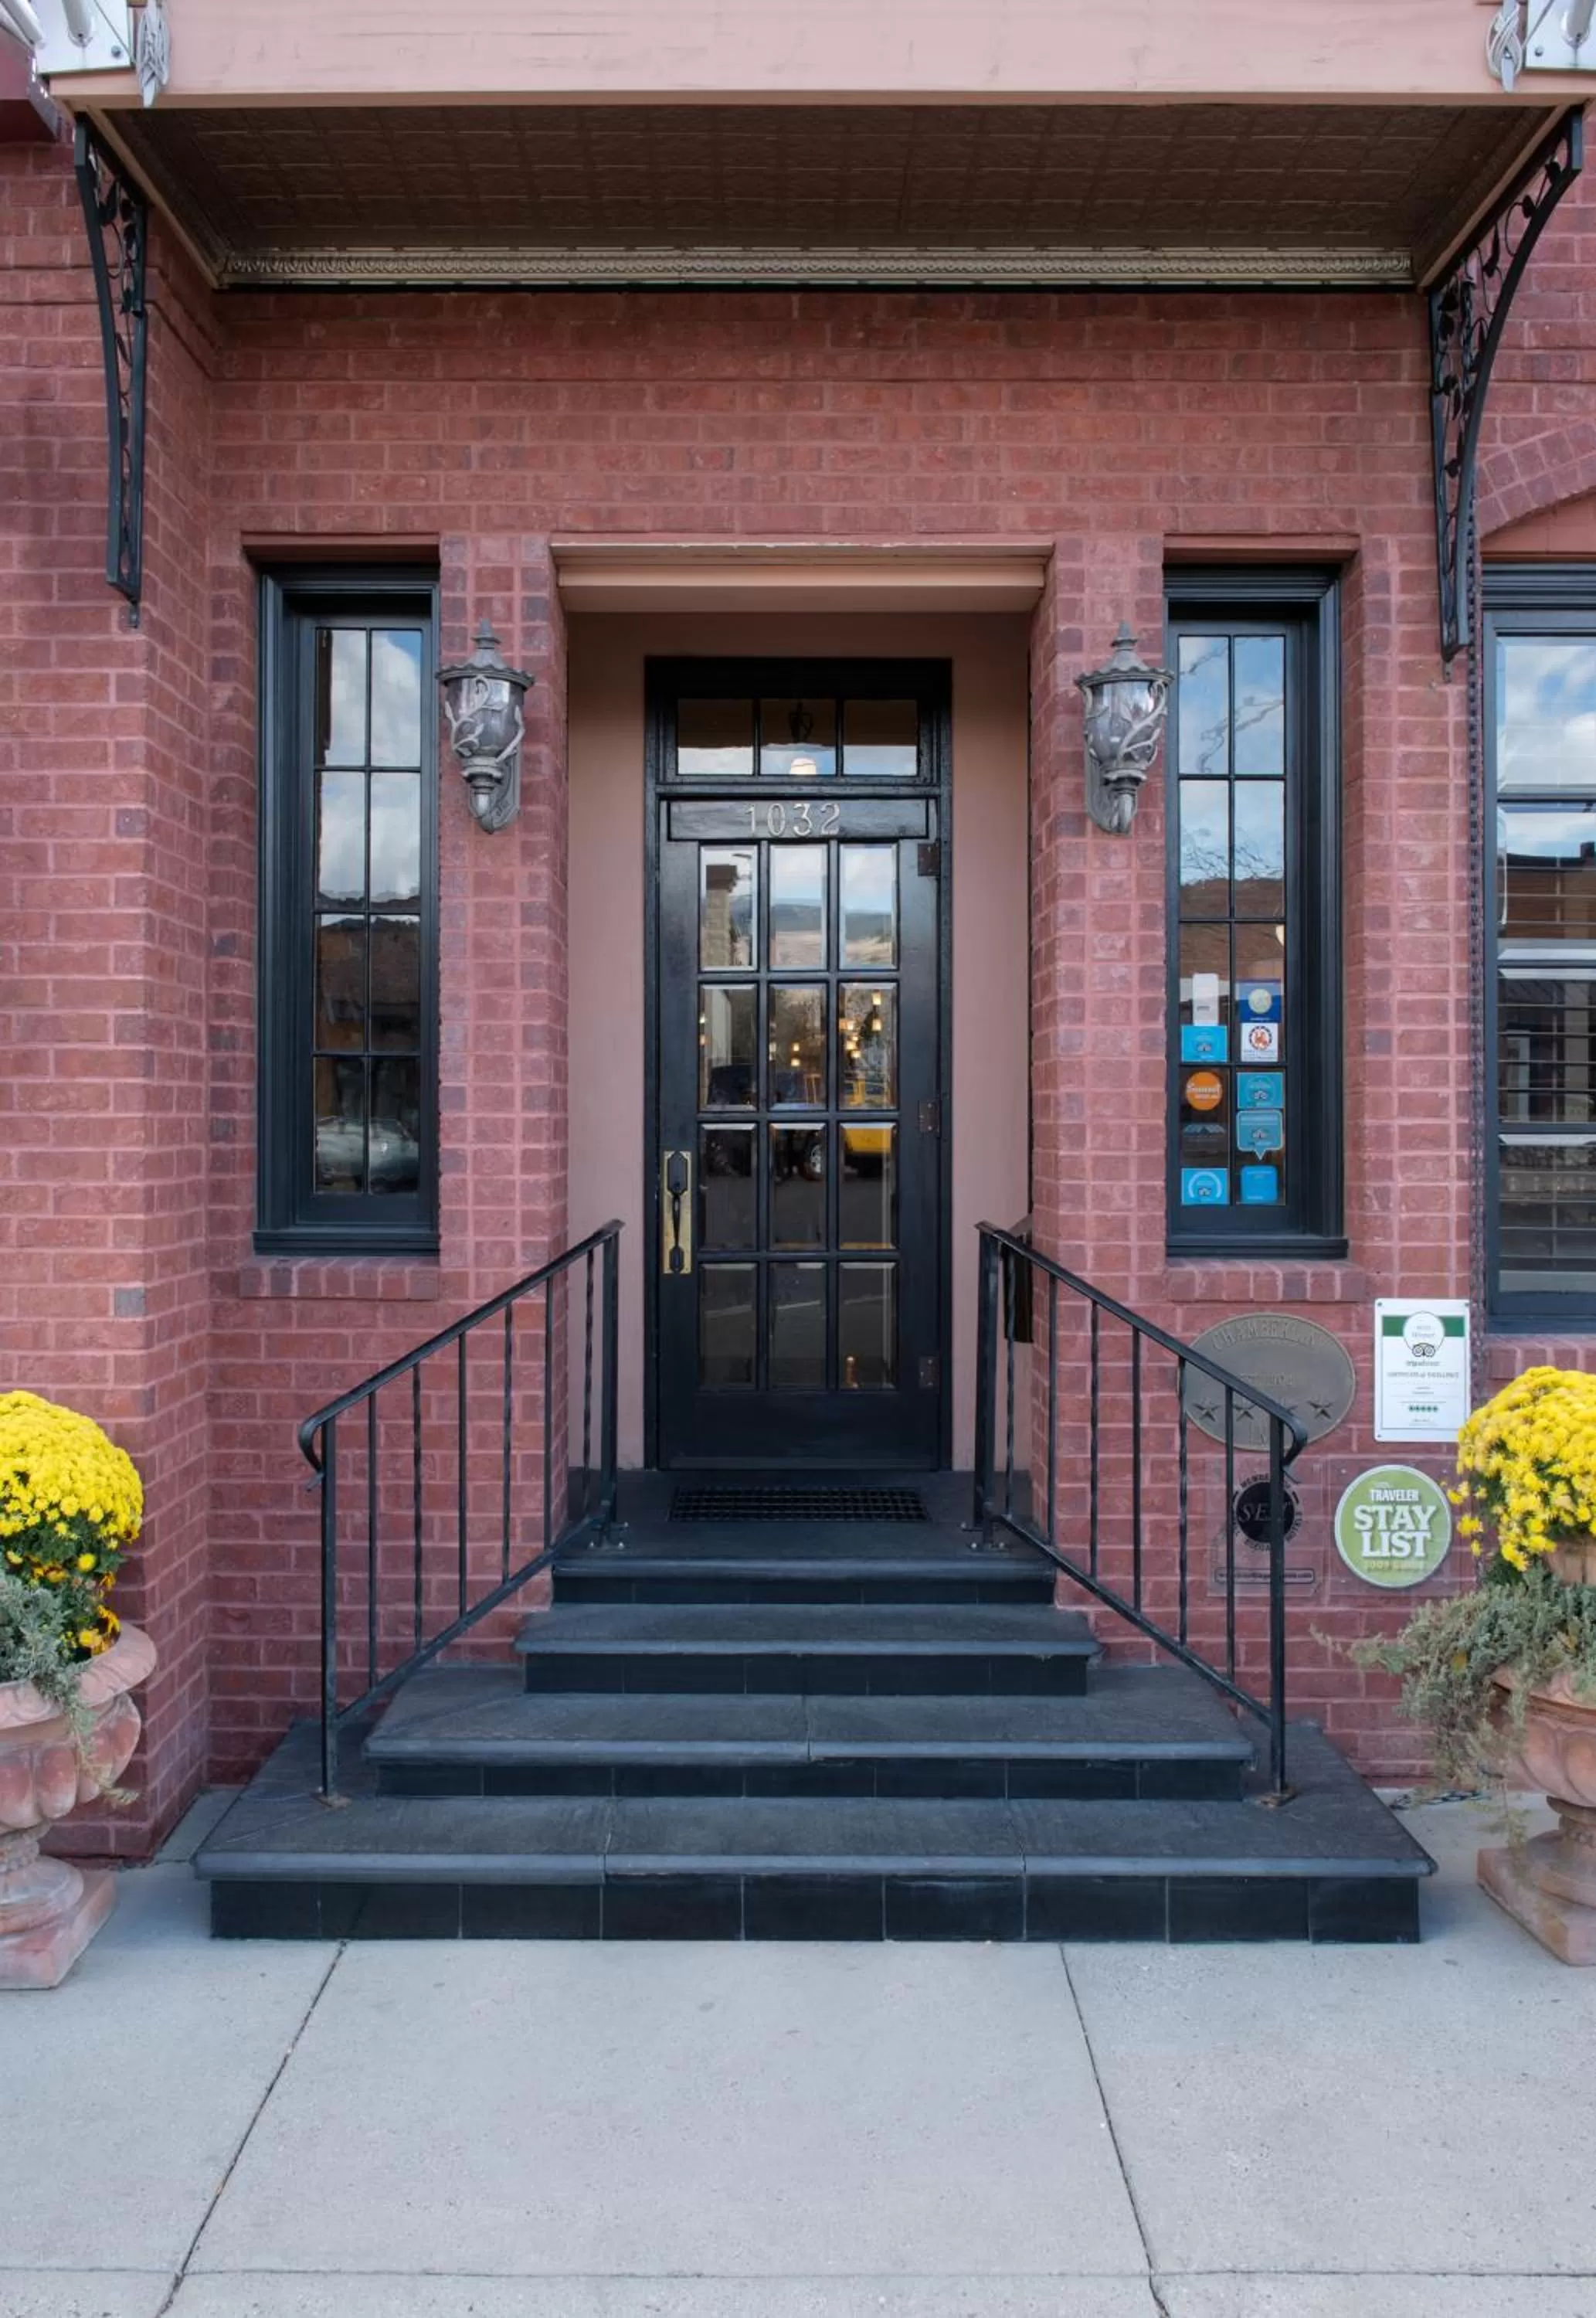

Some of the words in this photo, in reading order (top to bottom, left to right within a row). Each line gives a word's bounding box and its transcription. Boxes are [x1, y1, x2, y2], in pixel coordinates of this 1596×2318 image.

[745, 802, 841, 836] 1032
[1370, 1489, 1419, 1501] TRAVELER
[1353, 1504, 1437, 1531] STAY
[1361, 1531, 1431, 1558] LIST
